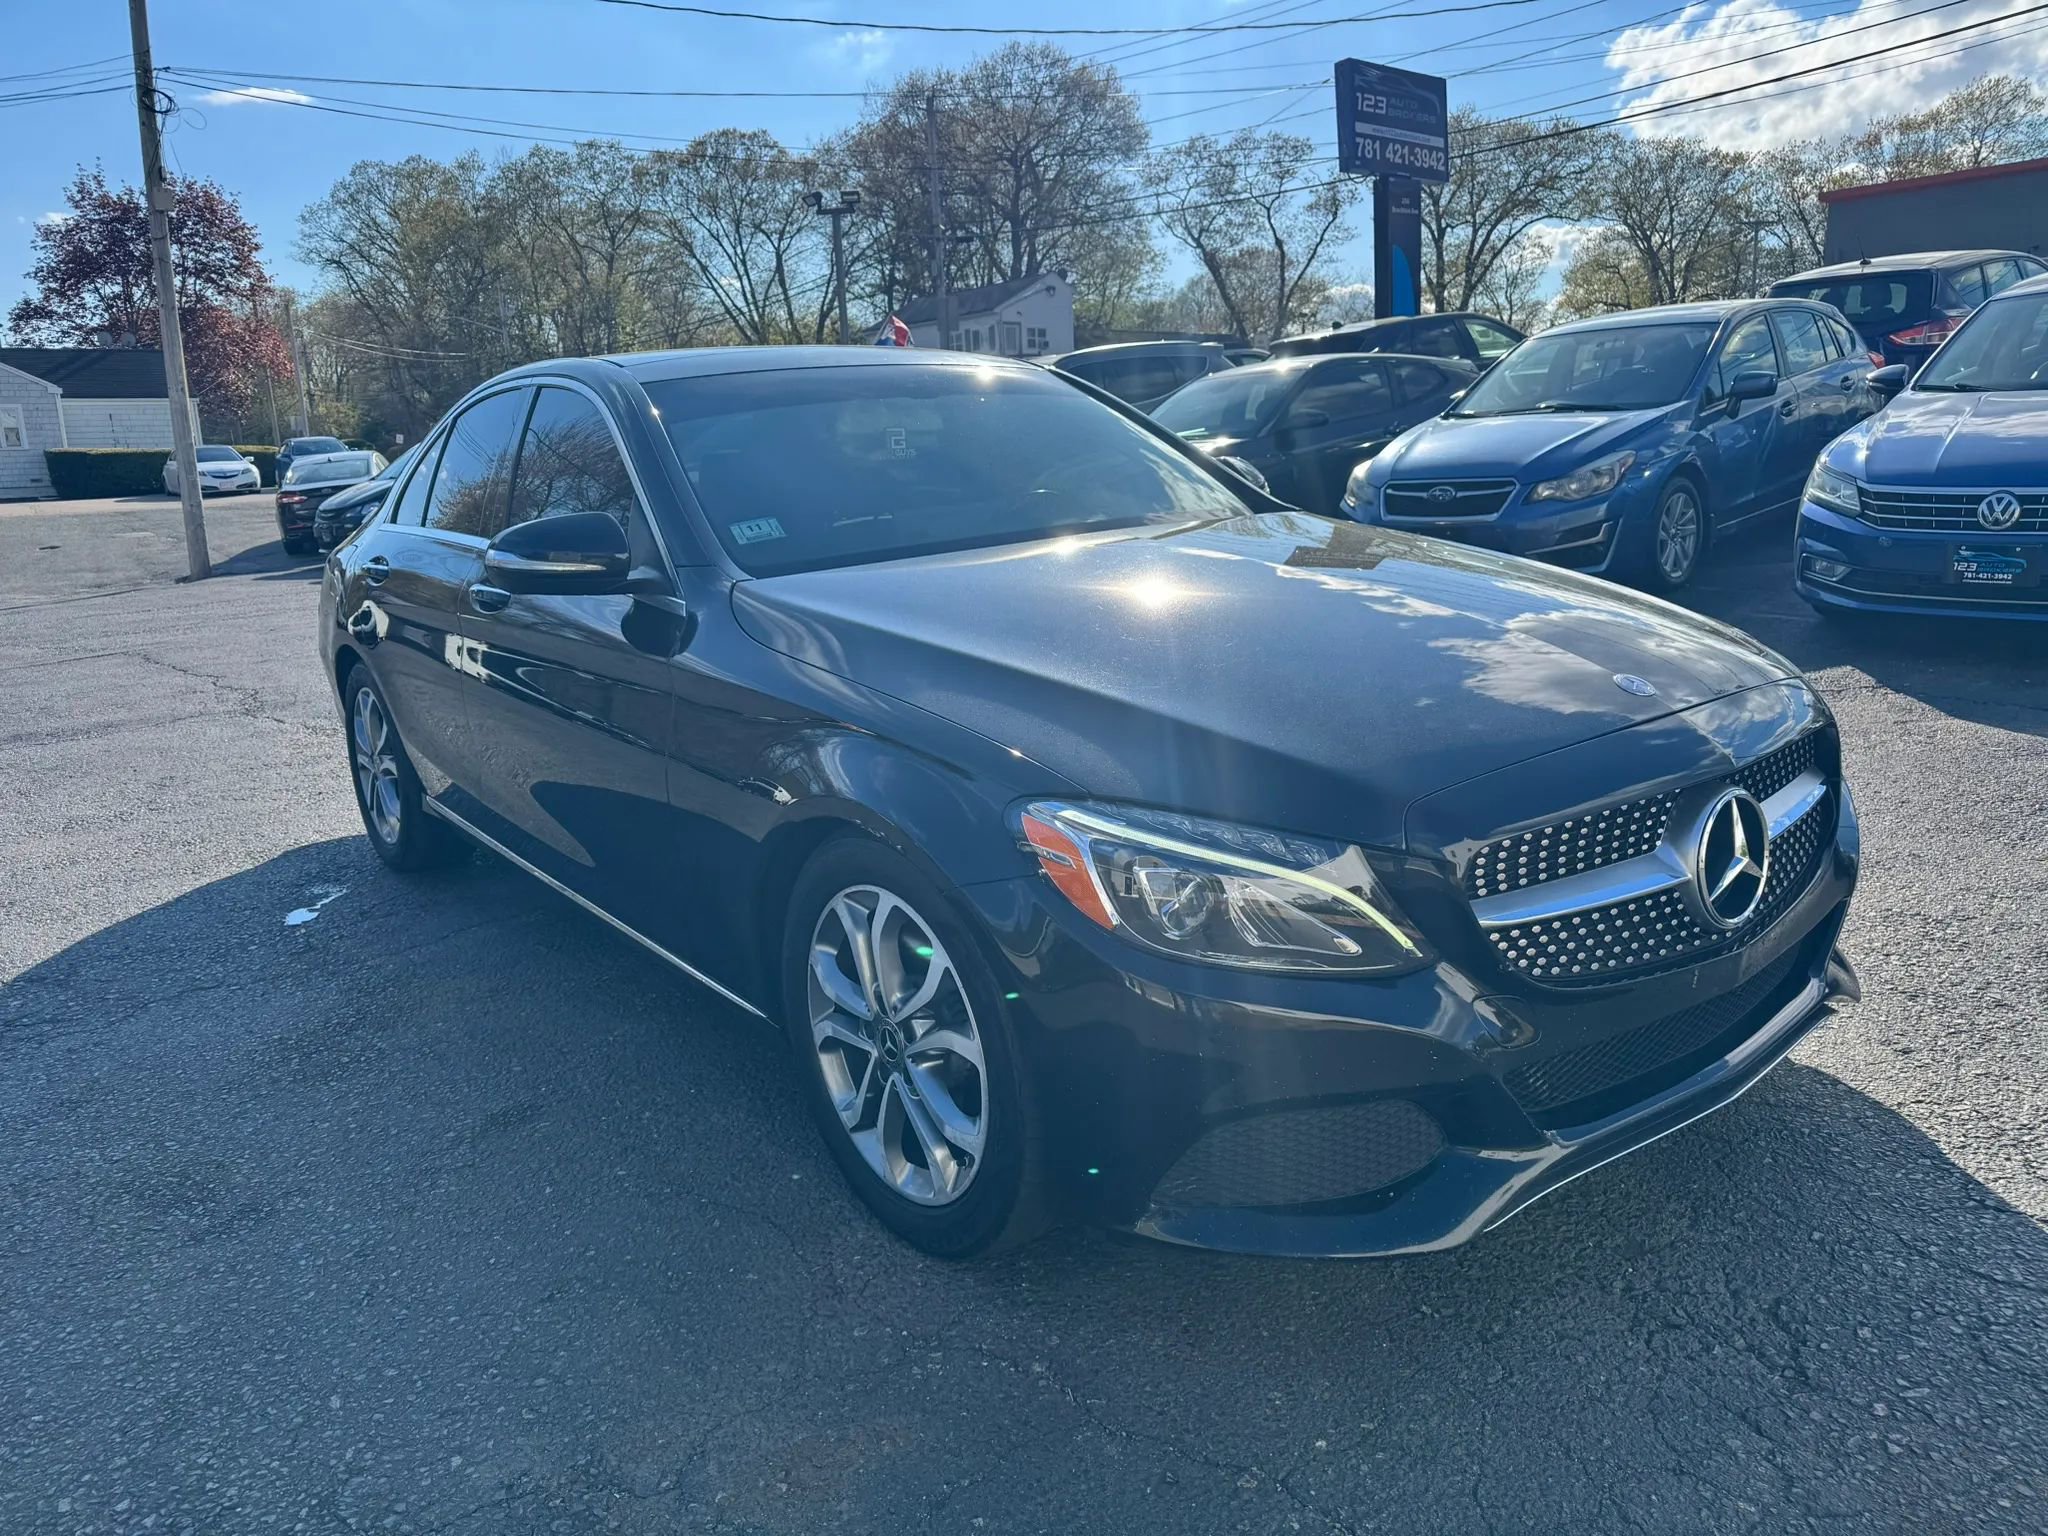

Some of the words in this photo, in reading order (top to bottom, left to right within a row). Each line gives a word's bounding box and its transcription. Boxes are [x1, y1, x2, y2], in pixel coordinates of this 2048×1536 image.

[1355, 92, 1387, 116] 123
[1389, 97, 1418, 110] AUTO
[1355, 136, 1381, 161] 781
[1385, 142, 1446, 172] 421-3942
[1953, 561, 1978, 572] 123
[1963, 572, 2013, 580] 781-421-3942
